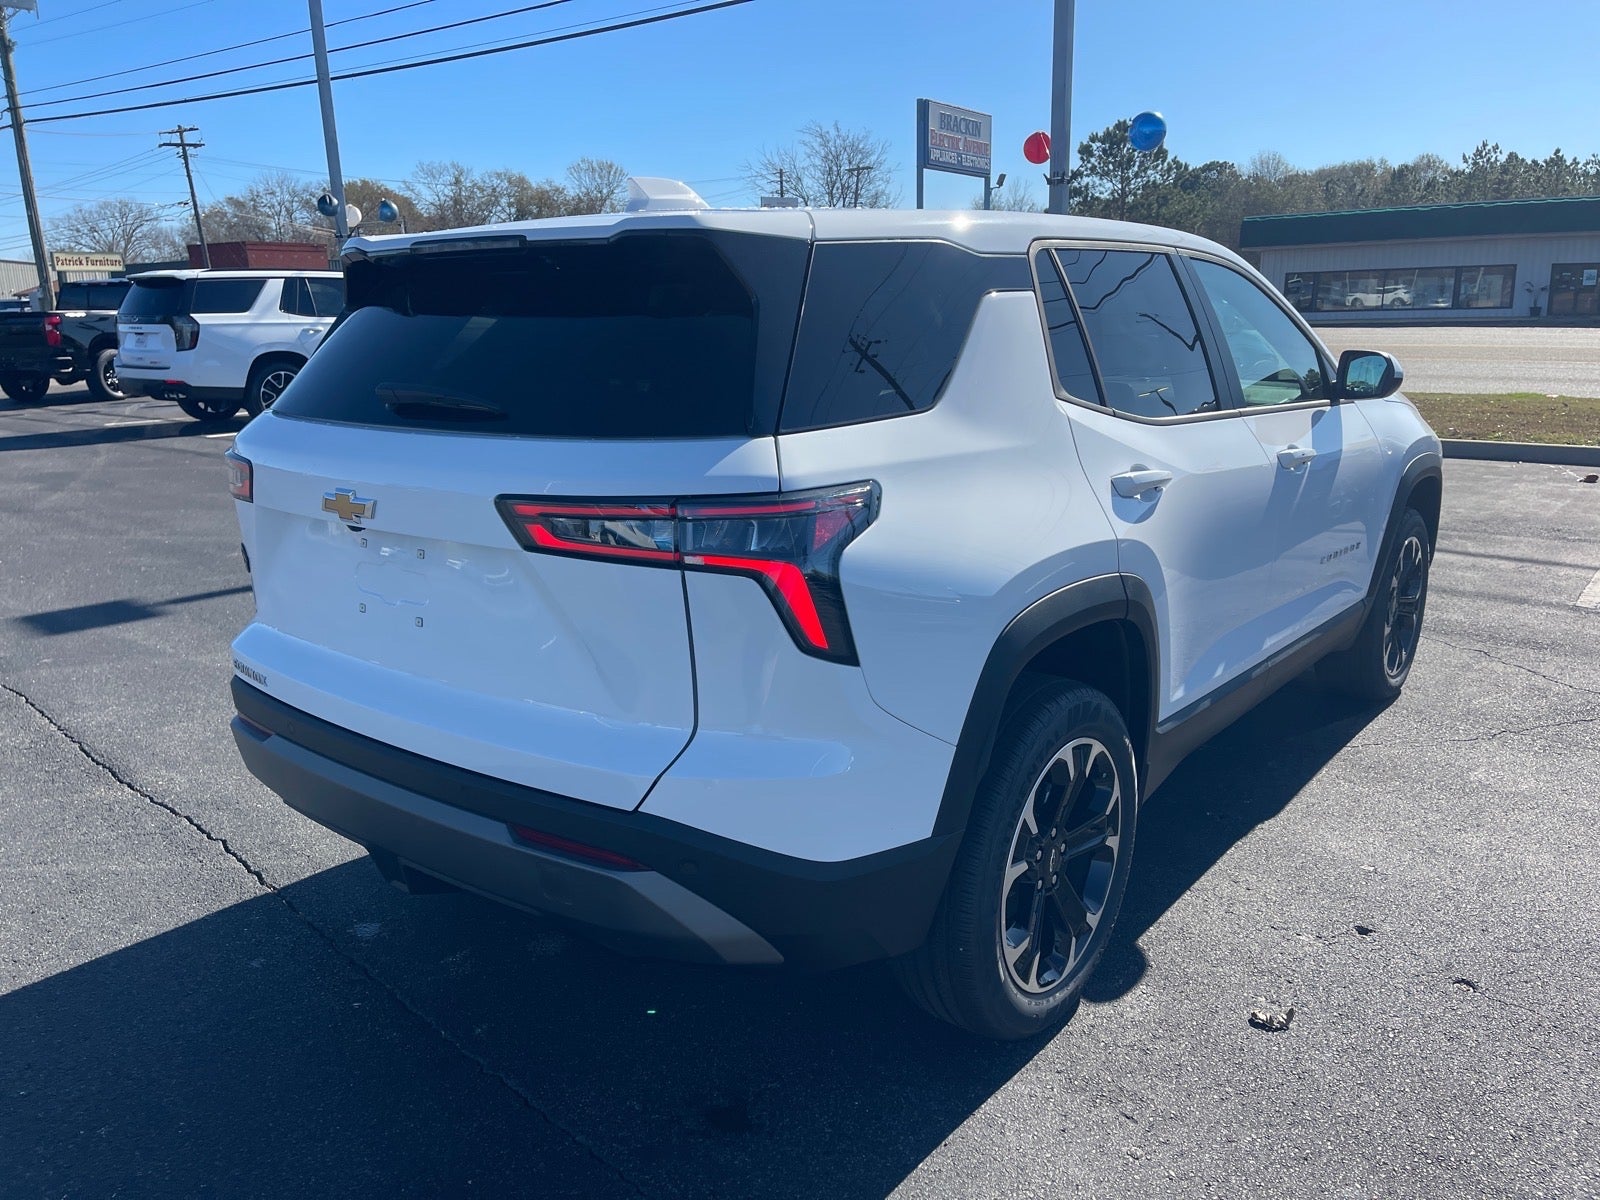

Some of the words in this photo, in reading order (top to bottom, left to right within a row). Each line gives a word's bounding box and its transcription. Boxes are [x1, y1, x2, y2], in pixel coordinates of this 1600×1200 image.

[940, 112, 982, 137] BRACKIN
[963, 136, 990, 156] AVENUE
[930, 149, 958, 164] APPLIANCES
[961, 154, 990, 170] ELECTRONICS
[55, 256, 84, 266] Patrick
[85, 256, 122, 267] Furniture
